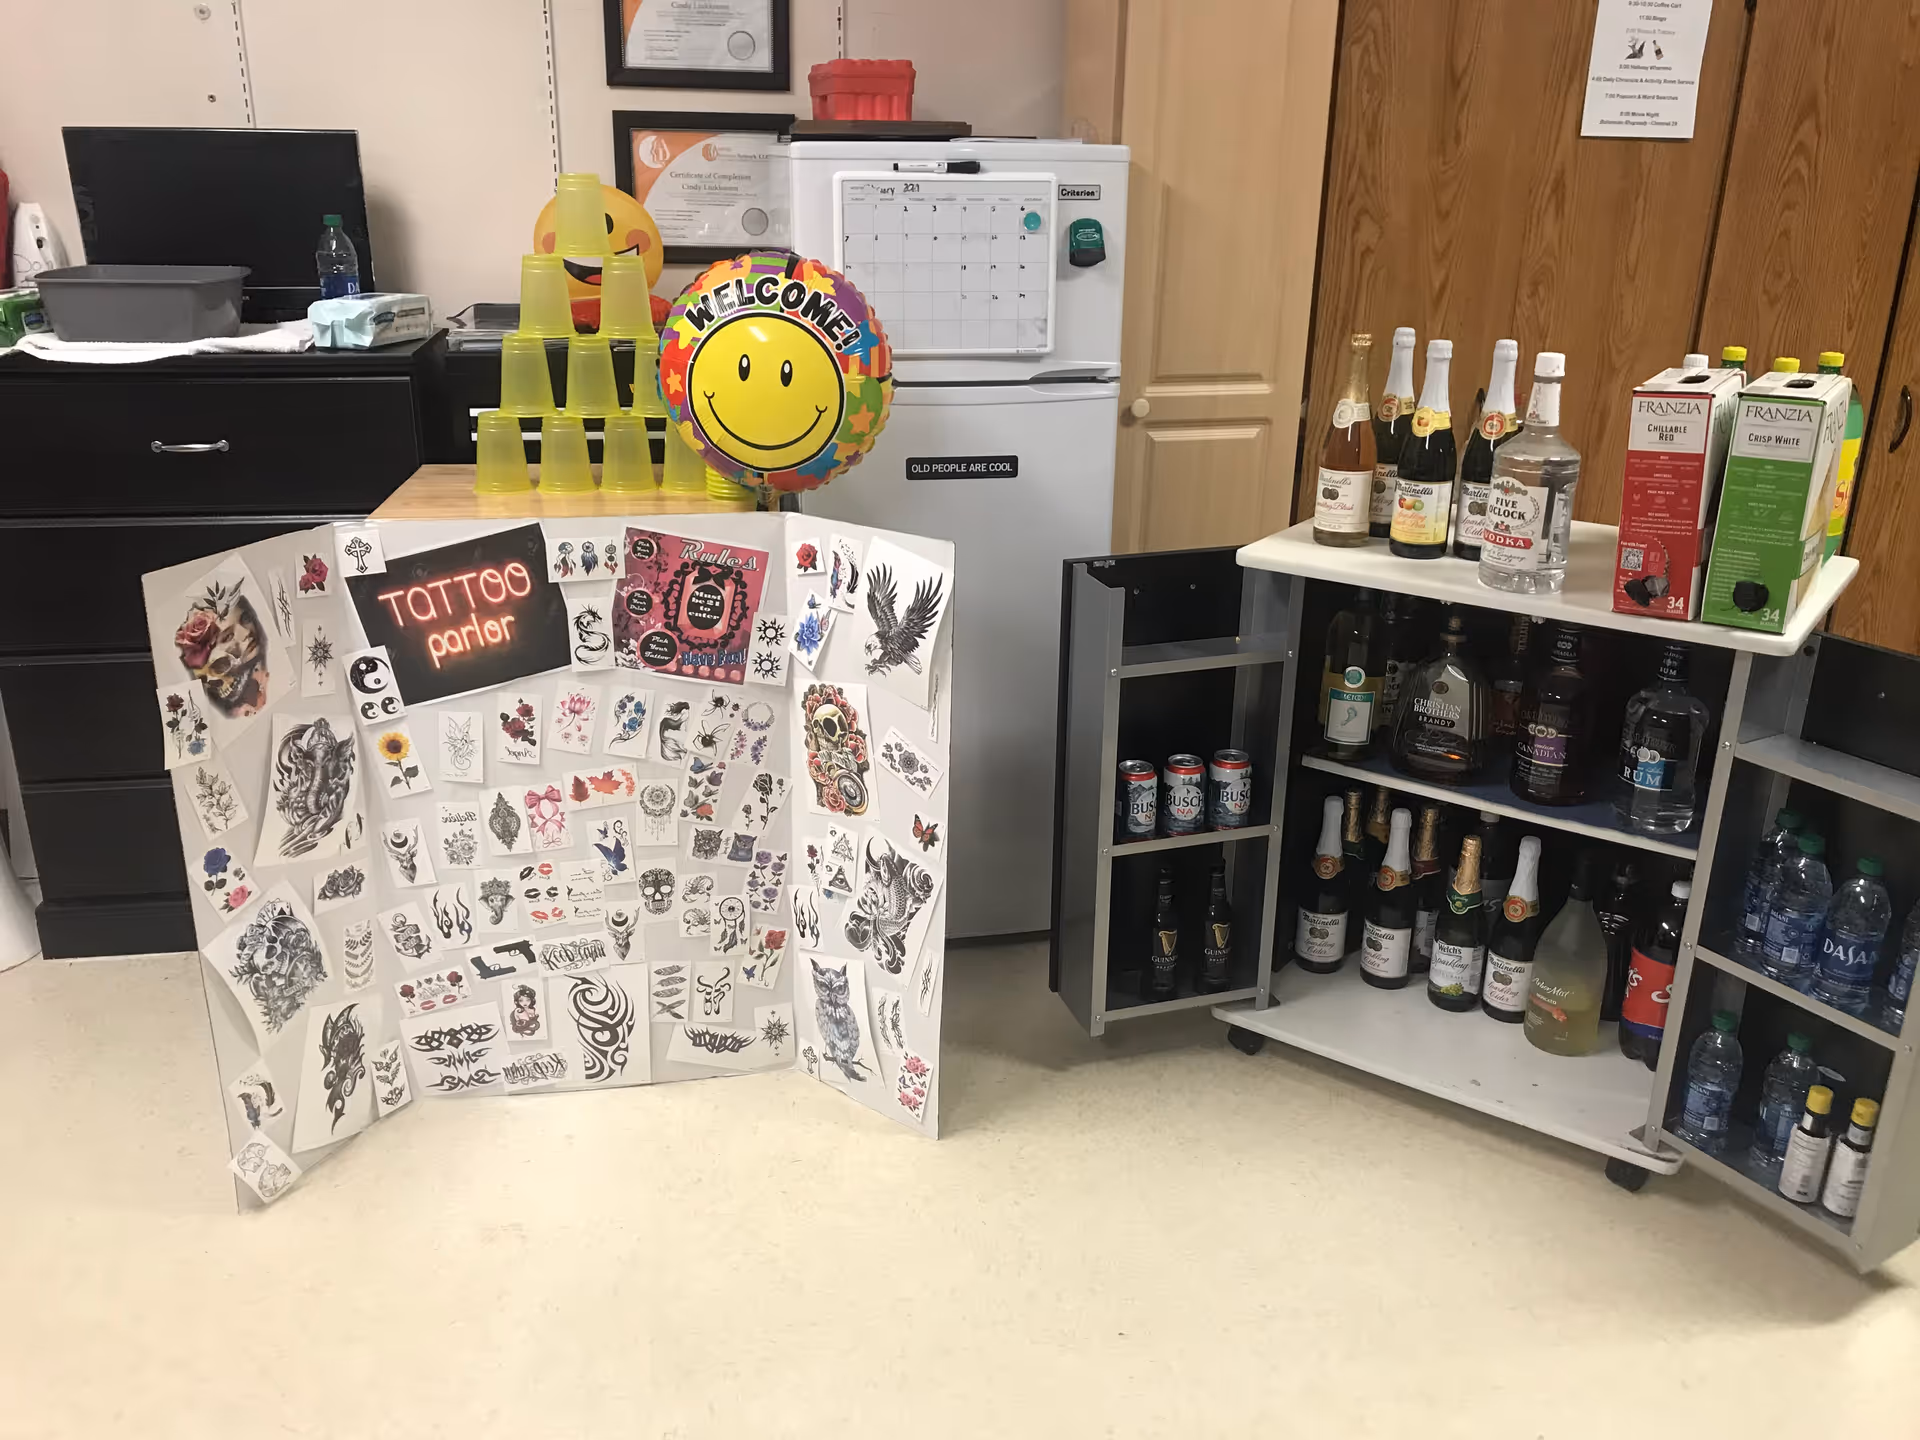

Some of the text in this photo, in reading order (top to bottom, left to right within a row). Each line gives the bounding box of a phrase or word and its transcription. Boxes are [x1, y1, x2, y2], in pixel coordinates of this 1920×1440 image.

[669, 171, 703, 179] Certificate
[713, 172, 751, 181] Completion
[1060, 188, 1095, 197] Criterion
[684, 276, 860, 351] WELCOME!
[1638, 400, 1702, 416] FRANZIA
[1745, 404, 1813, 423] FRANZIA
[911, 462, 1013, 473] OLD PEOPLE ARE COOL
[1495, 497, 1518, 509] FIVE
[1488, 504, 1527, 520] O'CLOCK
[1484, 529, 1525, 548] VODKA
[693, 590, 722, 600] Must
[1667, 596, 1684, 610] 34
[688, 611, 720, 620] enter
[1761, 607, 1780, 622] 34
[427, 612, 515, 669] parlor
[651, 635, 669, 644] Pick
[649, 643, 668, 652] Your
[644, 651, 672, 661] Tattoo
[681, 651, 716, 666] Have
[1413, 704, 1461, 720] BROTHERS
[1414, 697, 1462, 713] CHRISTIAN
[1418, 715, 1453, 728] BRANDY
[1517, 741, 1567, 760] CANADIAN
[1623, 765, 1662, 786] RUM
[1131, 800, 1157, 815] BUS
[1176, 807, 1194, 815] NA
[1438, 944, 1463, 955] Welch's
[1431, 953, 1470, 975] Sparkling
[1487, 953, 1526, 974] Martinelli's
